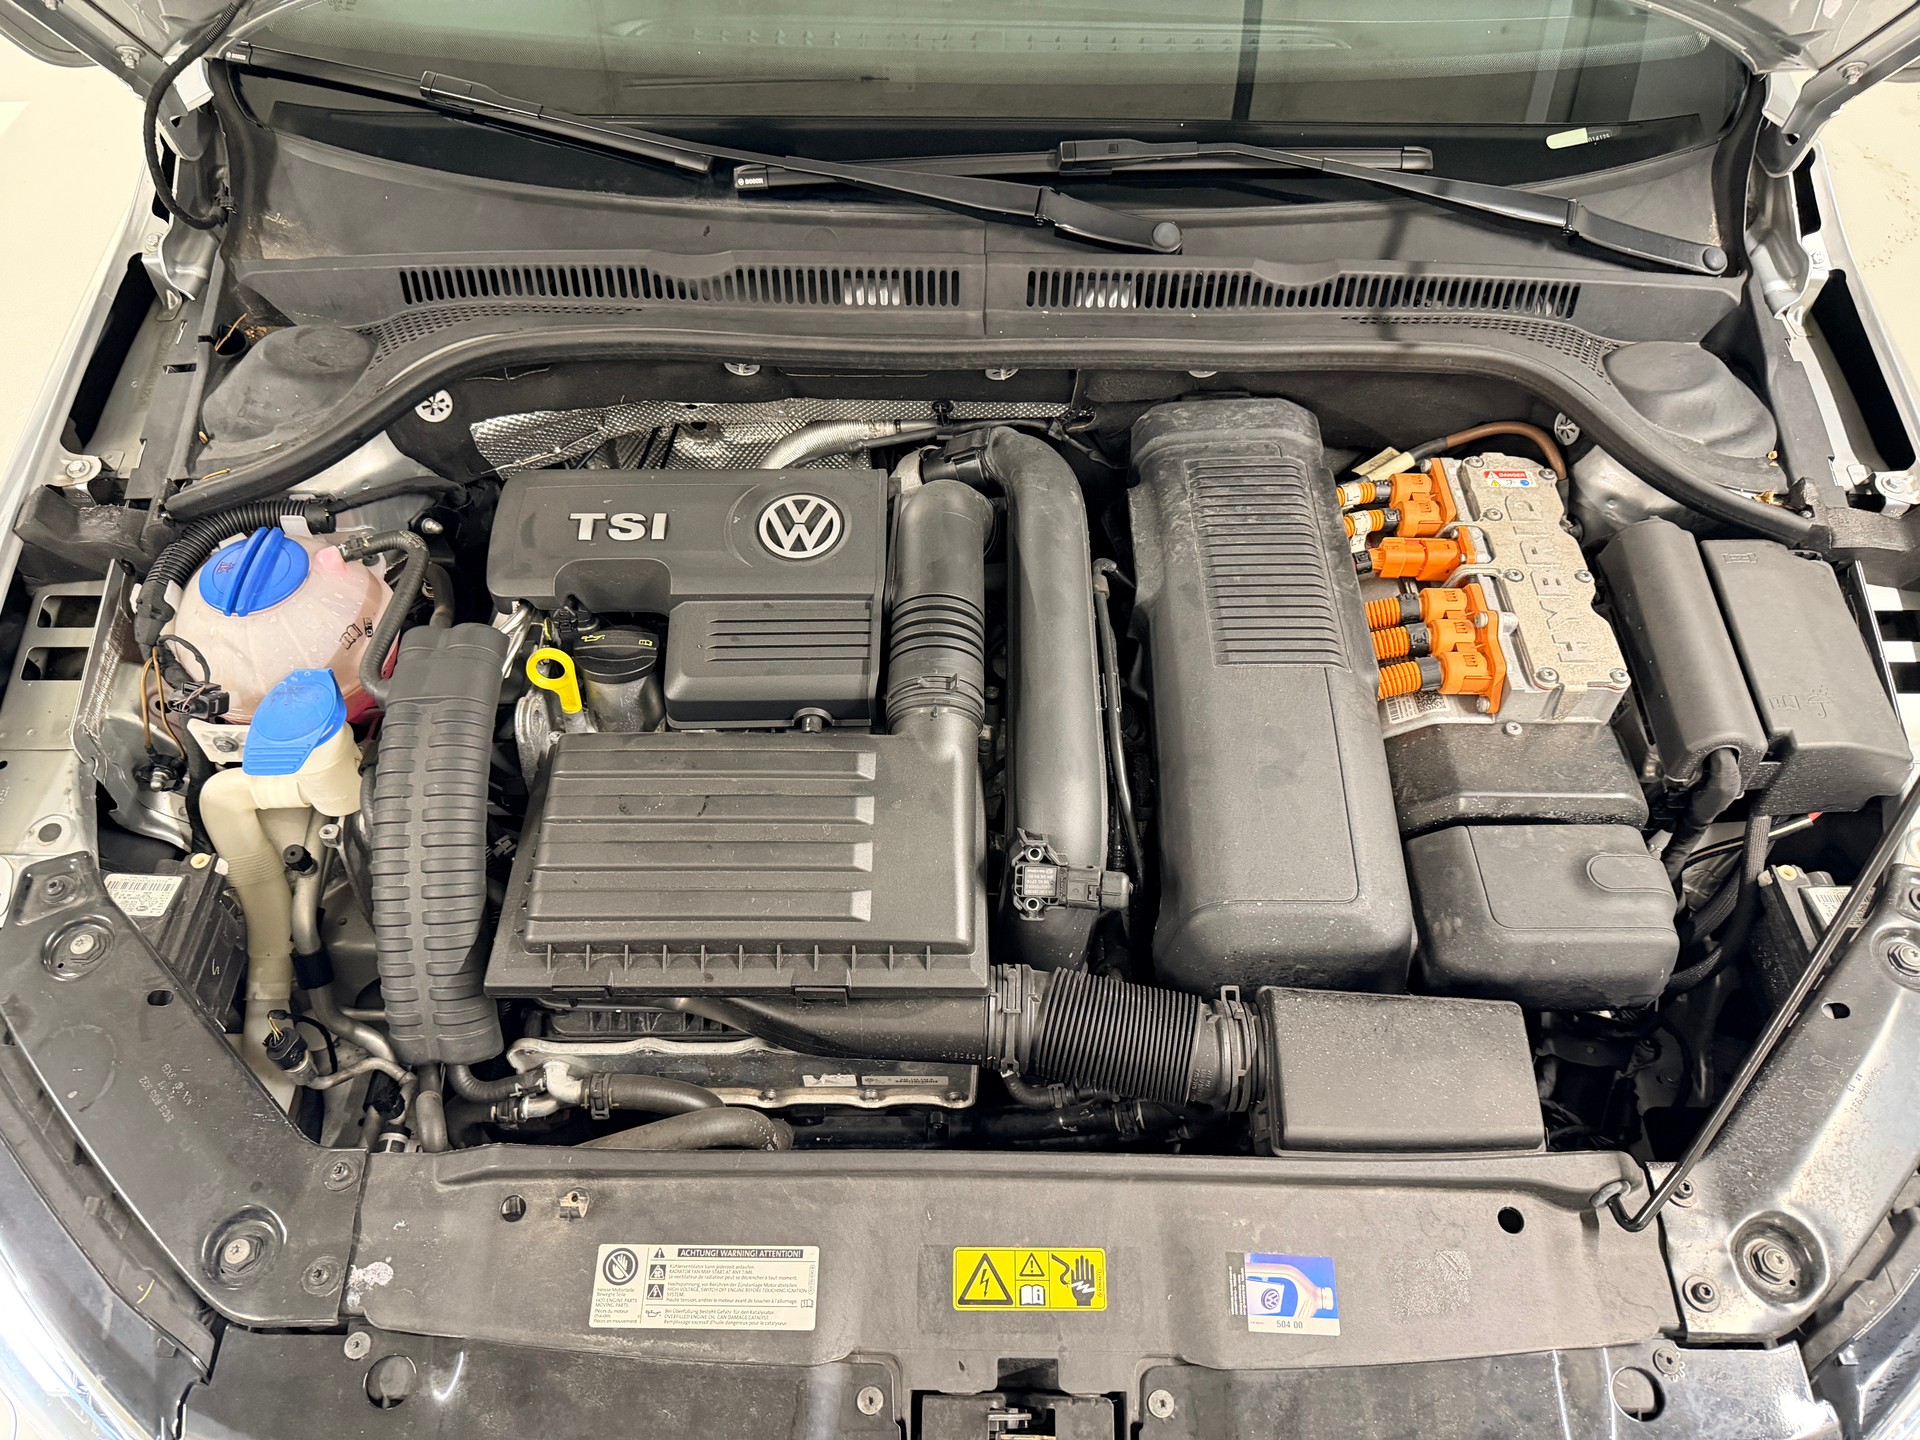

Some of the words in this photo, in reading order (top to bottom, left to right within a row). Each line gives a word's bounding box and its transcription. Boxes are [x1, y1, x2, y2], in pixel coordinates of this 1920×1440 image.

[569, 513, 668, 541] TSI
[1505, 495, 1597, 663] HYBRID
[680, 1249, 719, 1257] ACHTUNG!
[759, 1250, 801, 1258] ATTENTION!
[1276, 1320, 1291, 1328] 504
[1294, 1321, 1303, 1329] 00
